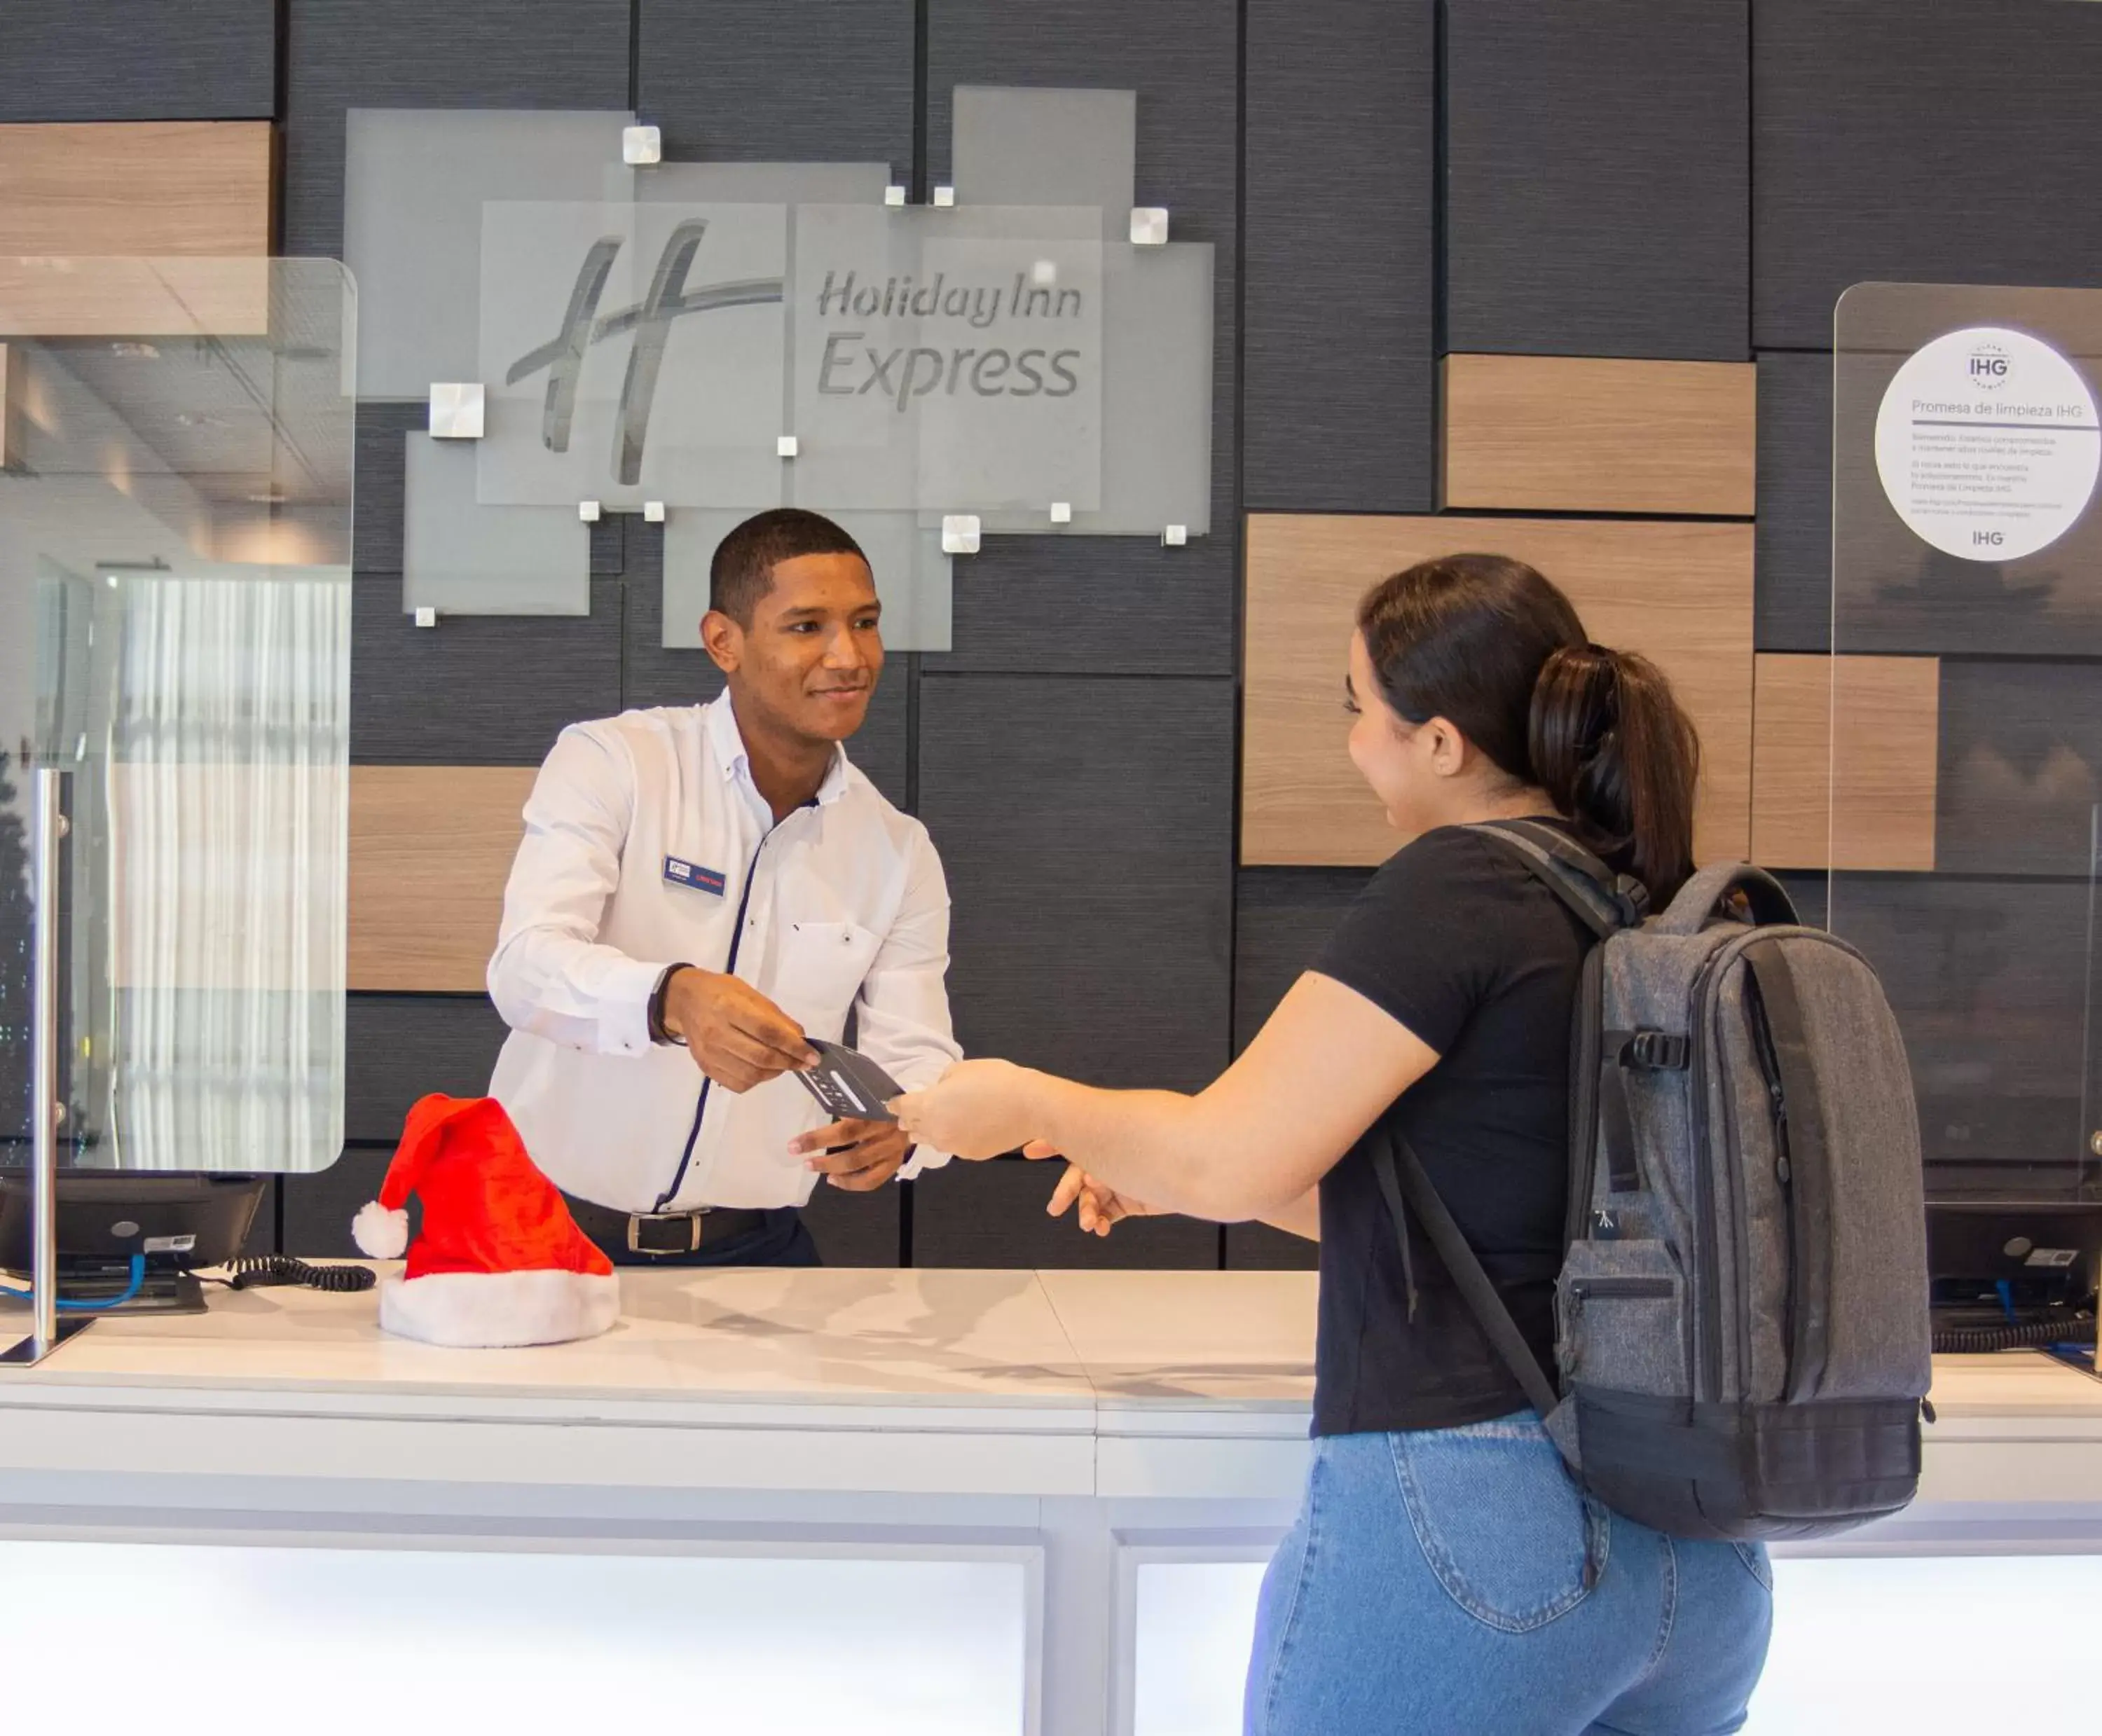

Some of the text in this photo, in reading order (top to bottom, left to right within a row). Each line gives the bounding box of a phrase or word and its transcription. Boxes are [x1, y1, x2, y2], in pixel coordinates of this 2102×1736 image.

[816, 269, 1082, 329] Holiday Inn
[818, 331, 1081, 413] Express
[1970, 358, 2007, 376] IHG
[1911, 399, 1972, 414] Promesa
[1974, 401, 1992, 415] de
[1995, 402, 2052, 418] limpieza
[1972, 530, 2003, 546] IHG
